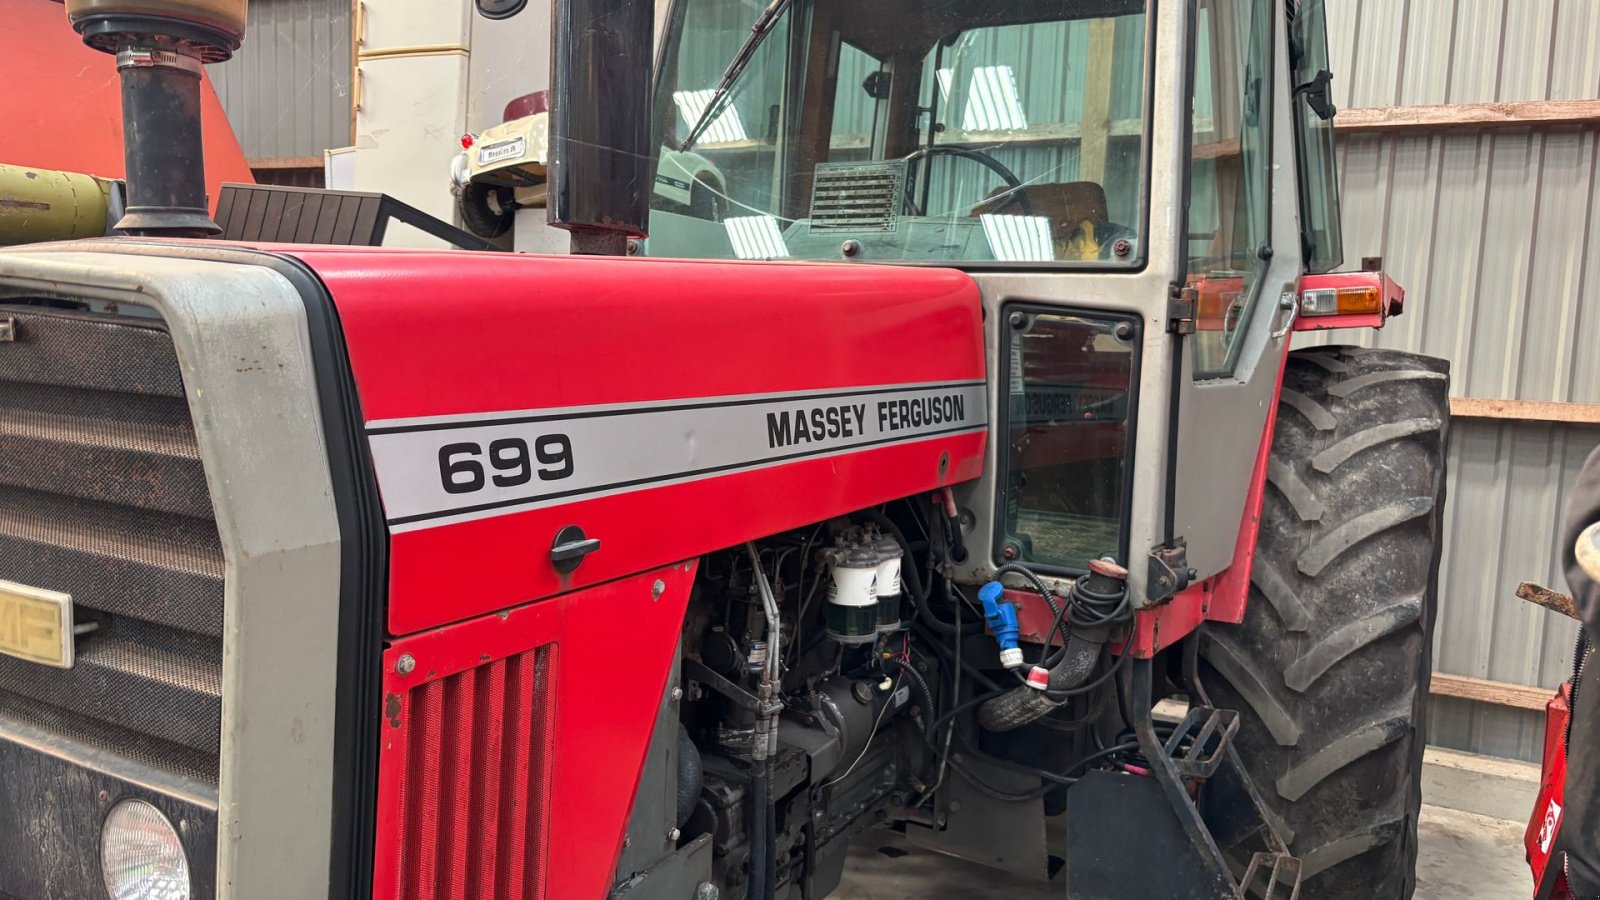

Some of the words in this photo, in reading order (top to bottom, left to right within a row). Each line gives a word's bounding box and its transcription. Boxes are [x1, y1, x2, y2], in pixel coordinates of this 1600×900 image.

[767, 403, 866, 448] MASSEY
[878, 394, 965, 433] FERGUSON
[438, 433, 574, 494] 699
